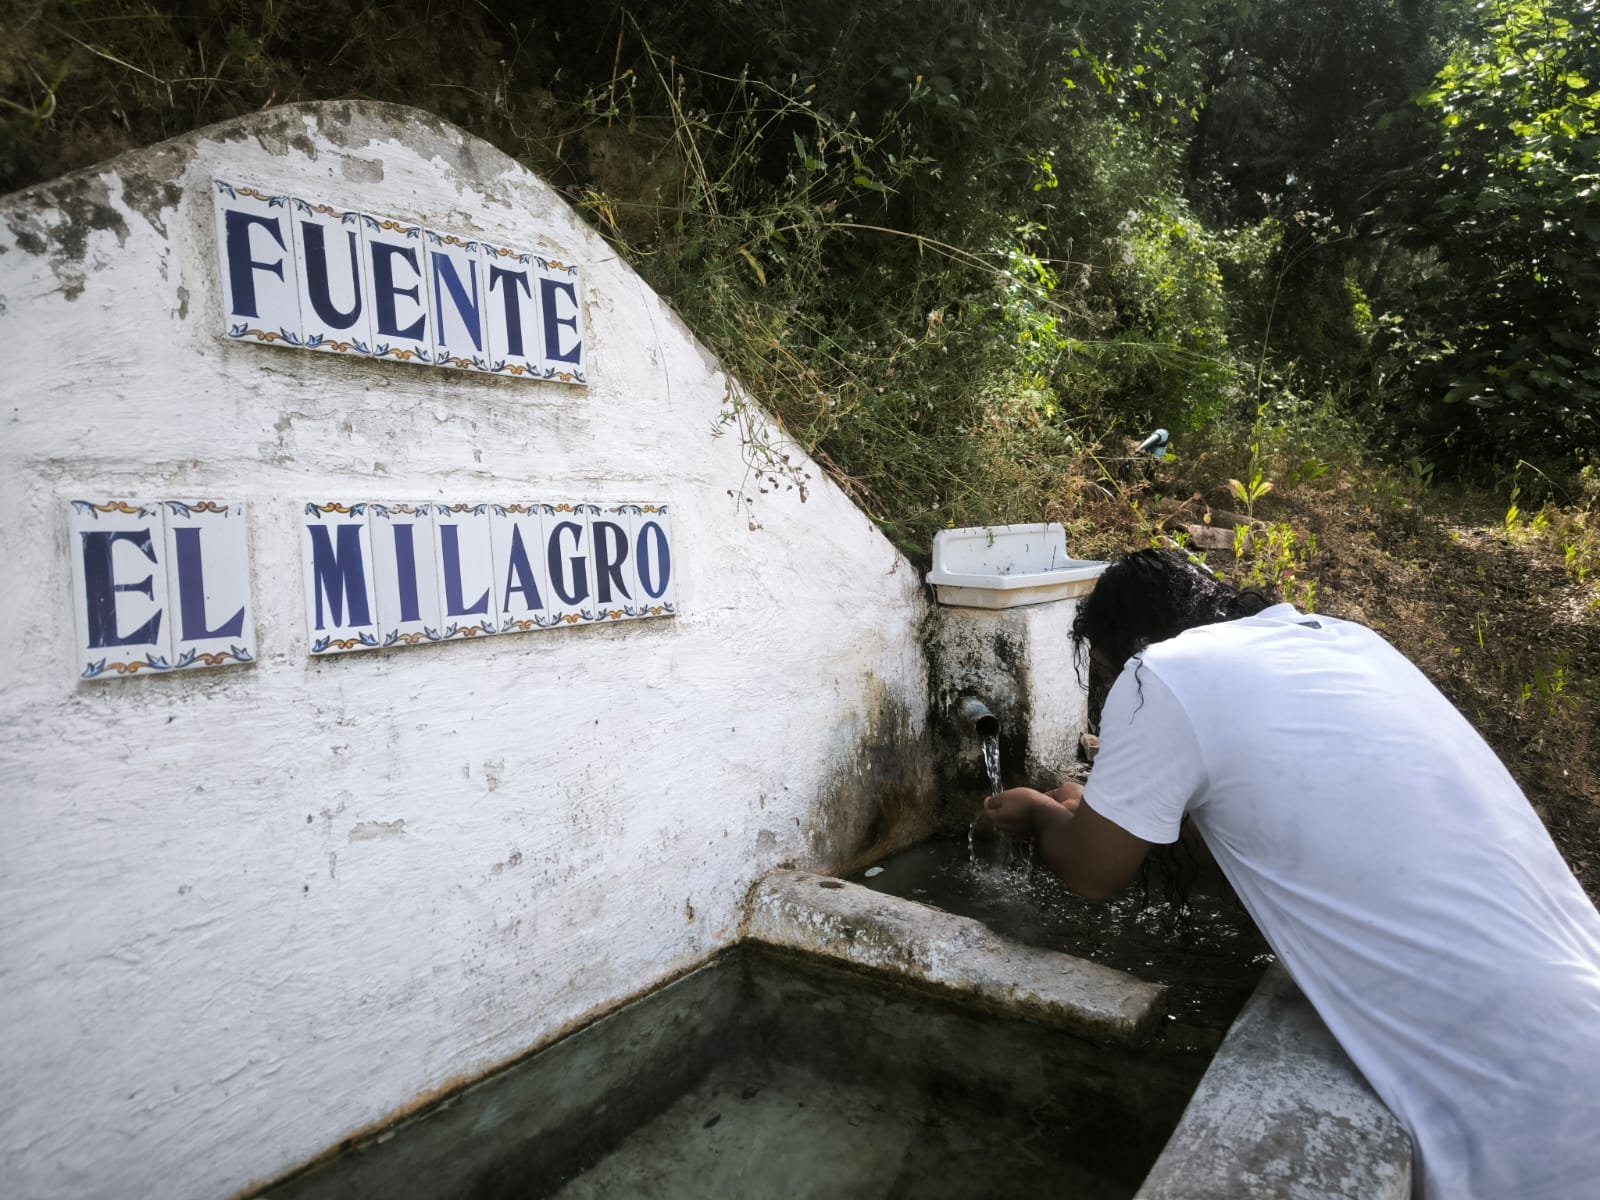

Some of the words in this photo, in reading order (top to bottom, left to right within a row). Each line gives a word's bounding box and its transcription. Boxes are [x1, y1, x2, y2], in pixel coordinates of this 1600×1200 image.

[225, 210, 582, 364] FUENTE
[81, 527, 245, 649] EL
[307, 521, 671, 631] MILAGRO
